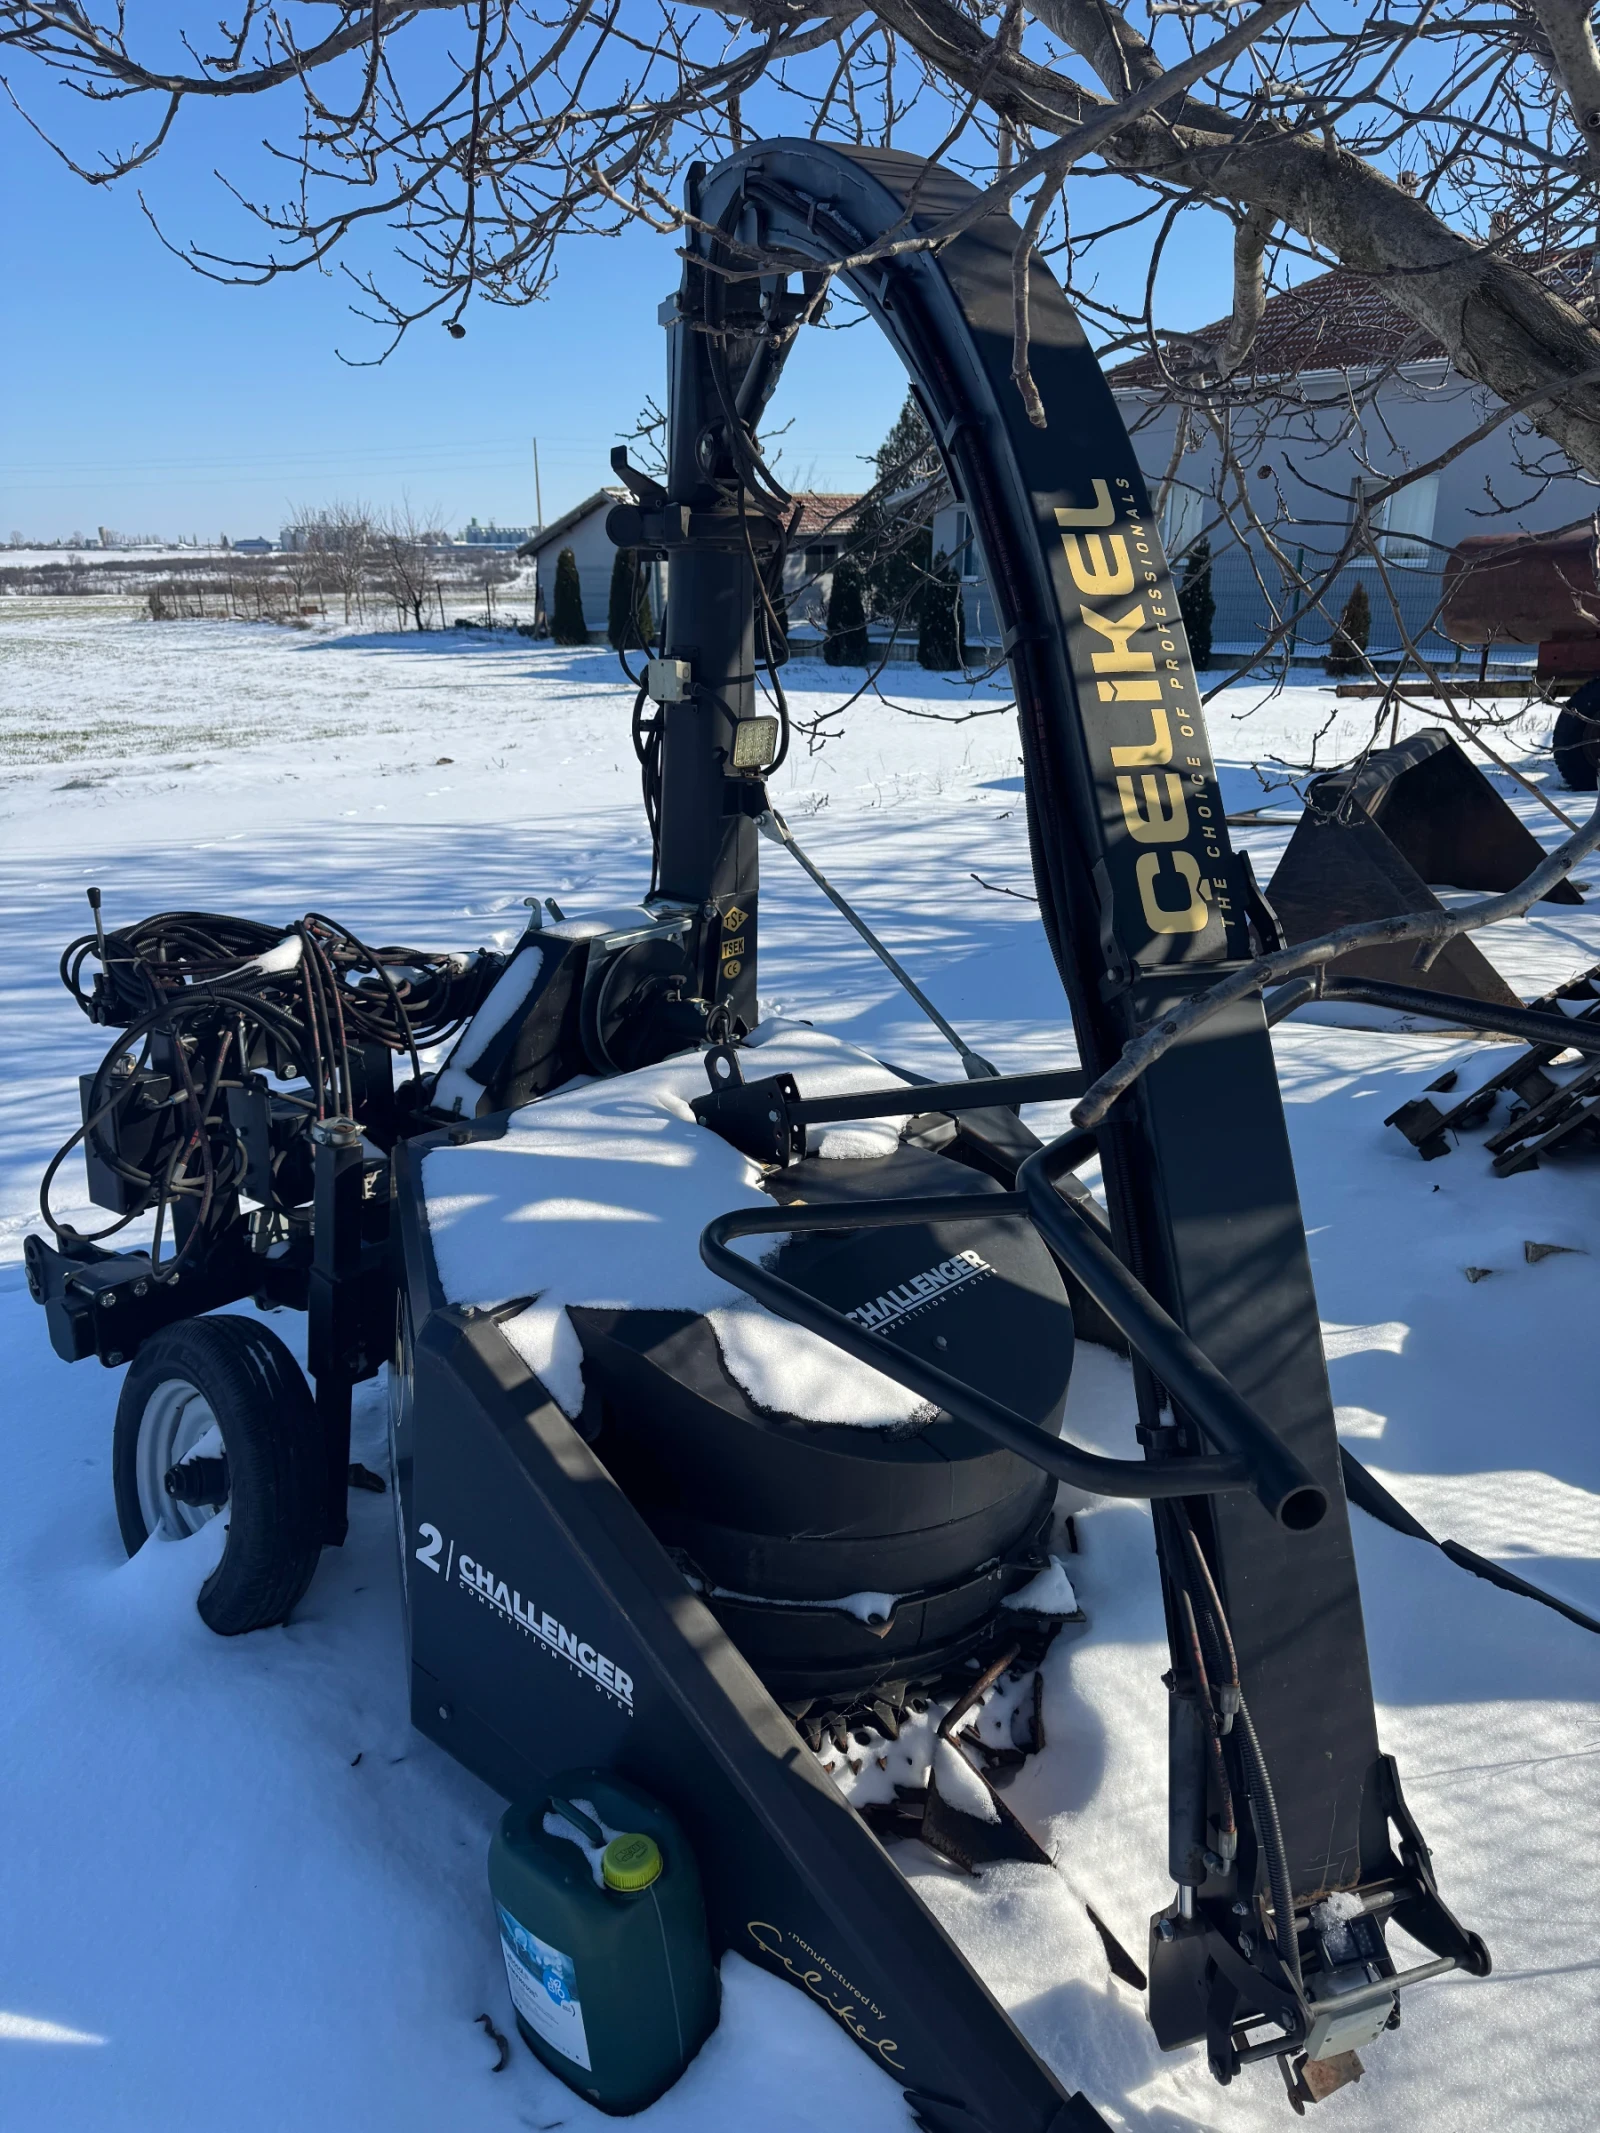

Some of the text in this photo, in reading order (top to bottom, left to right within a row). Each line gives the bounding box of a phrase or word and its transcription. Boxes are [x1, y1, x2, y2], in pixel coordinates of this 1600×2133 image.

[1116, 476, 1236, 928] THE CHOICE OF PROFESSIONALS
[723, 938, 744, 956] TSEK
[725, 911, 743, 928] TSE
[727, 962, 738, 976] CE
[844, 1249, 988, 1329] CHALLENGER
[880, 1267, 998, 1336] MPETITION IS OVER
[415, 1522, 634, 1702] 2 CHALLENGER
[459, 1581, 635, 1718] COMPETITION IS OVER
[870, 2002, 887, 2021] by
